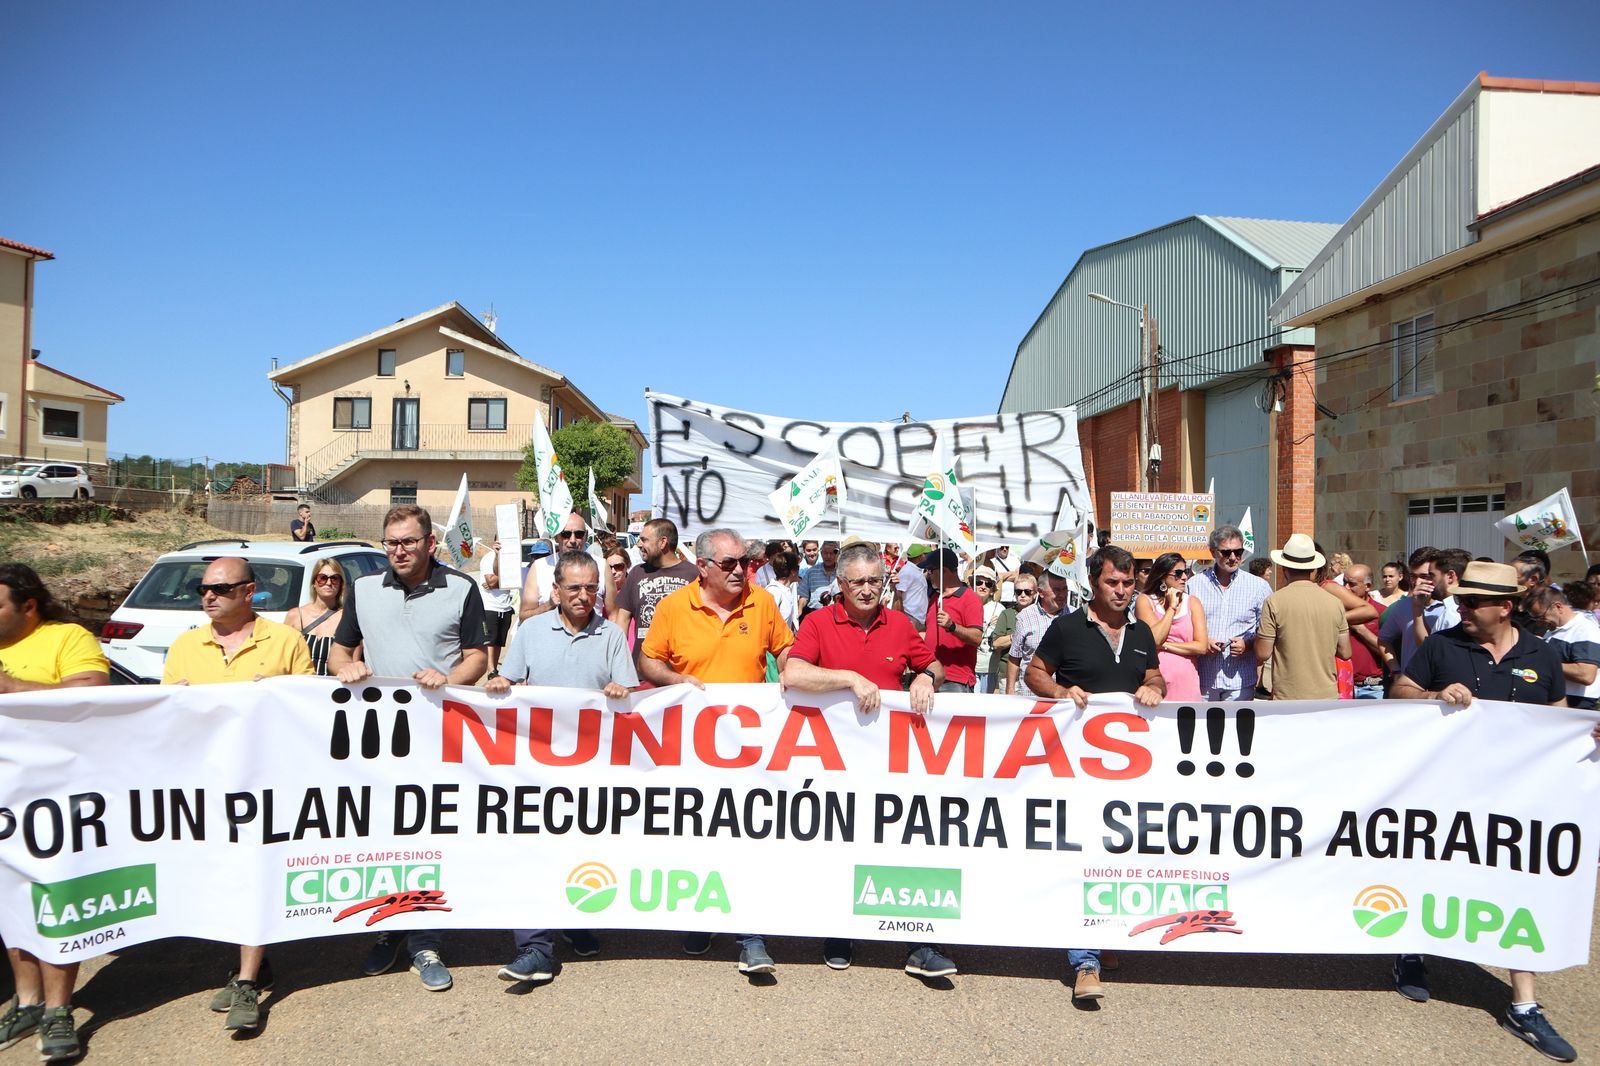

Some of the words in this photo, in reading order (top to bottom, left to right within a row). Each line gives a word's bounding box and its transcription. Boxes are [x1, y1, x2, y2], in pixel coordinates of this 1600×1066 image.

[661, 468, 727, 529] NO
[920, 496, 936, 516] PA
[1126, 502, 1153, 510] SIENTE
[1144, 513, 1189, 521] ABANDONO
[1171, 535, 1208, 543] CULEBRA
[639, 576, 689, 599] ADVENTURES
[441, 699, 846, 771] NUNCA
[888, 700, 1153, 780] MÁS
[130, 788, 205, 842] UN
[225, 785, 371, 844] PLAN
[393, 784, 459, 836] DE
[477, 778, 855, 843] RECUPERACIÓN
[875, 794, 1008, 849] PARA
[1026, 797, 1082, 851] EL
[1102, 799, 1302, 859] SECTOR
[1325, 808, 1582, 877] AGRARIO
[286, 853, 331, 867] UNIÓN
[334, 852, 354, 864] DE
[356, 850, 443, 863] CAMPESINOS
[289, 865, 440, 904] COAG
[1083, 866, 1124, 878] UNIÓN
[1126, 868, 1144, 878] DE
[1147, 869, 1230, 881] CAMPESINOS
[630, 867, 731, 914] UPA
[1087, 883, 1224, 914] COAG
[285, 905, 333, 918] ZAMORA
[1421, 893, 1545, 953] UPA
[878, 920, 935, 933] ZAMORA
[59, 927, 126, 954] ZAMORA
